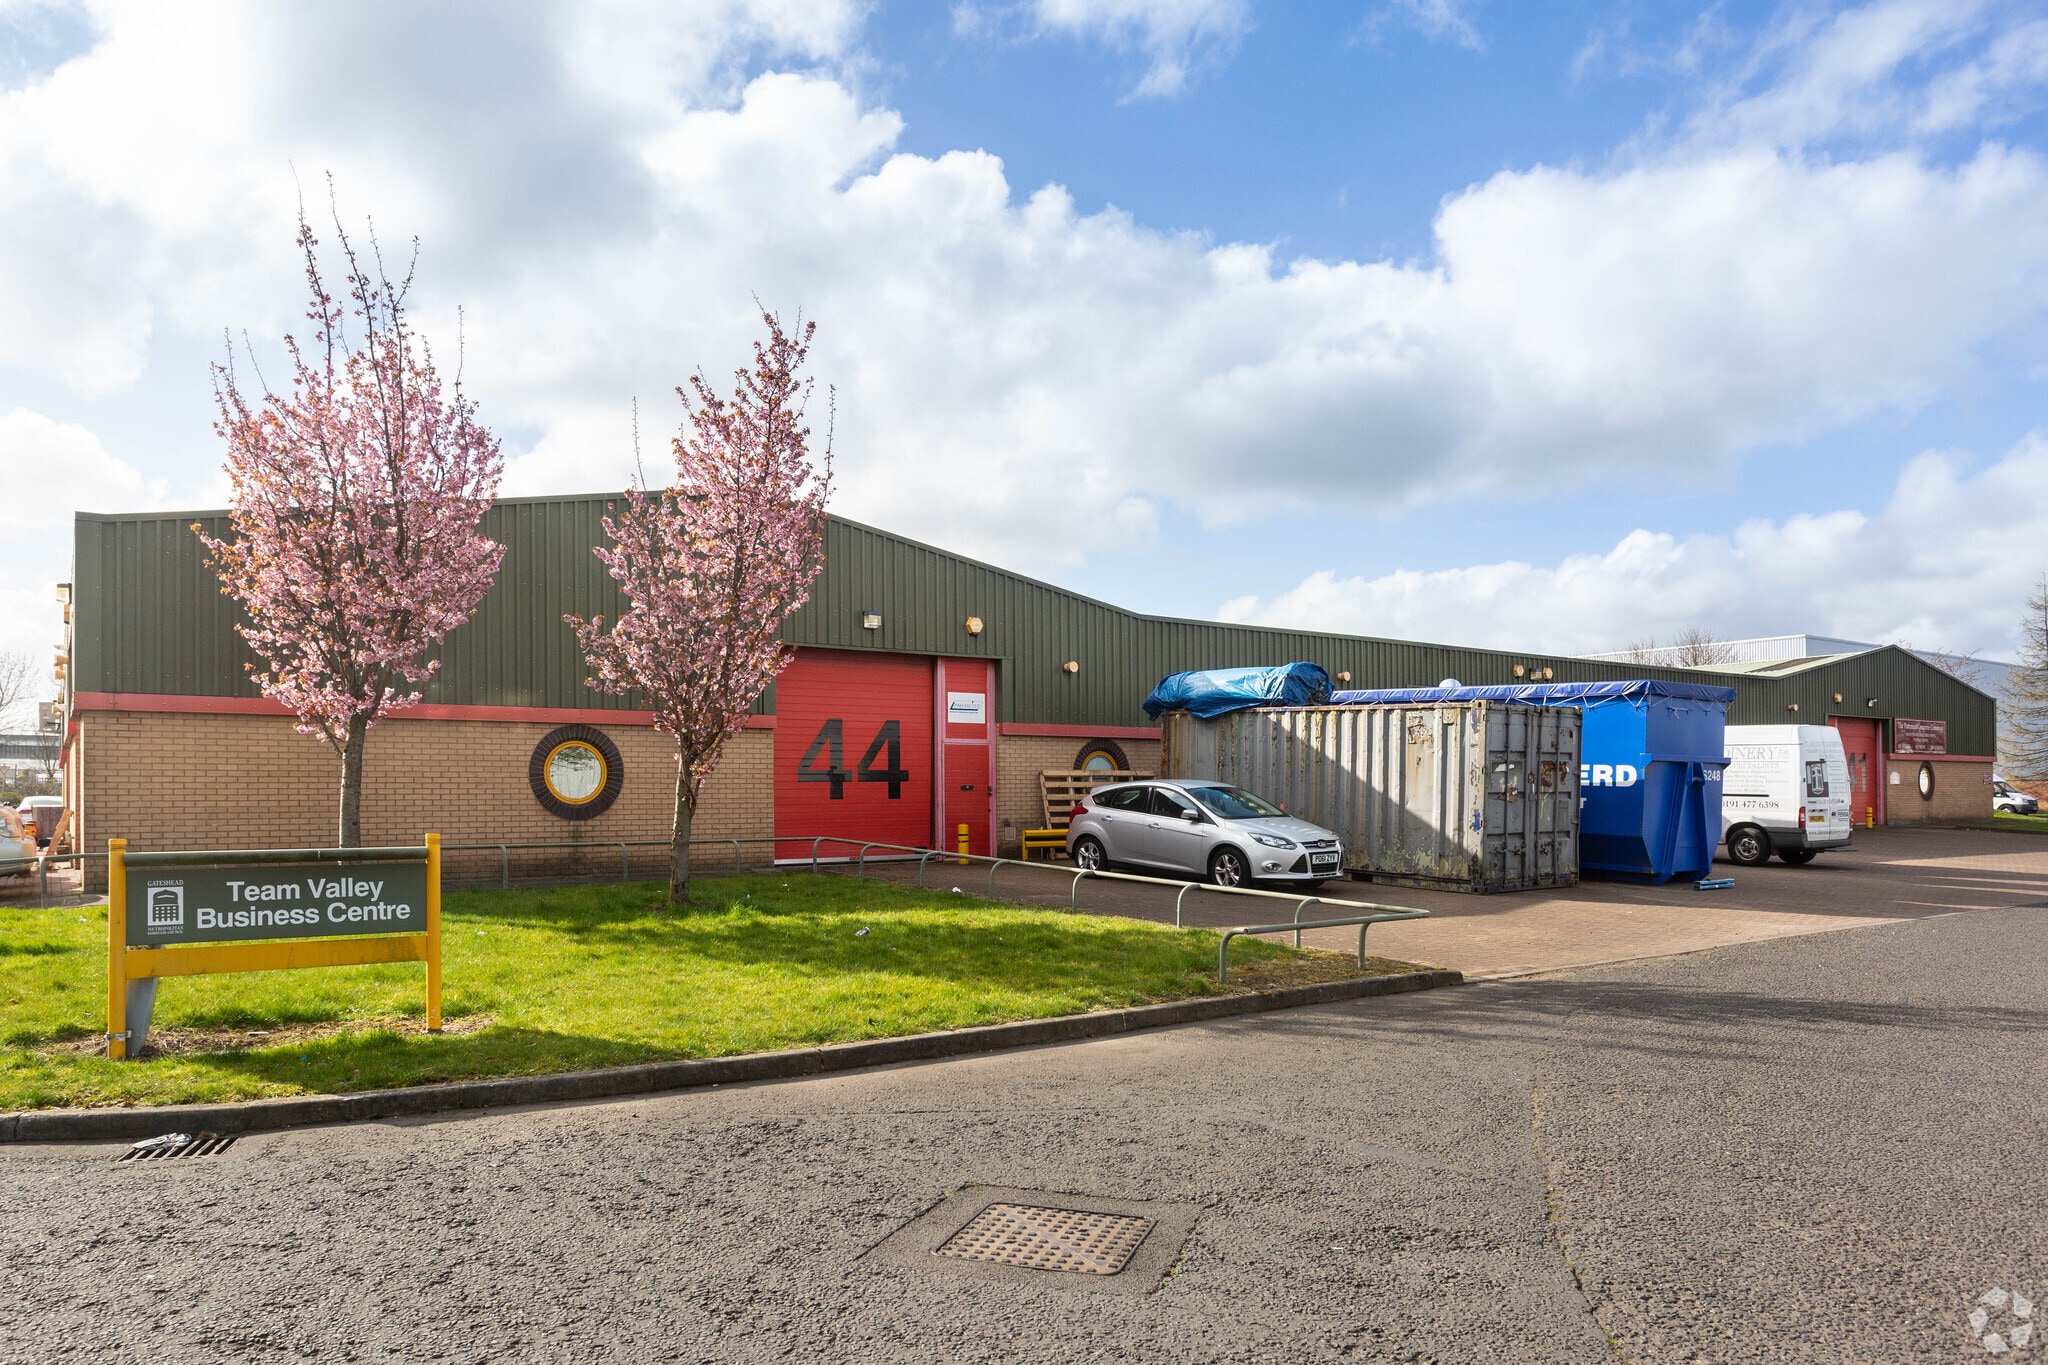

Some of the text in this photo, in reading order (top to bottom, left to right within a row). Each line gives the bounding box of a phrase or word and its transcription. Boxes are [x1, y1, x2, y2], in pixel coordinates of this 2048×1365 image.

[797, 718, 909, 800] 44
[1741, 800, 1757, 808] 477
[1758, 800, 1780, 809] 6398
[147, 879, 184, 887] GATESHEAD
[225, 878, 384, 902] Team Valley
[197, 901, 411, 929] Business Centre
